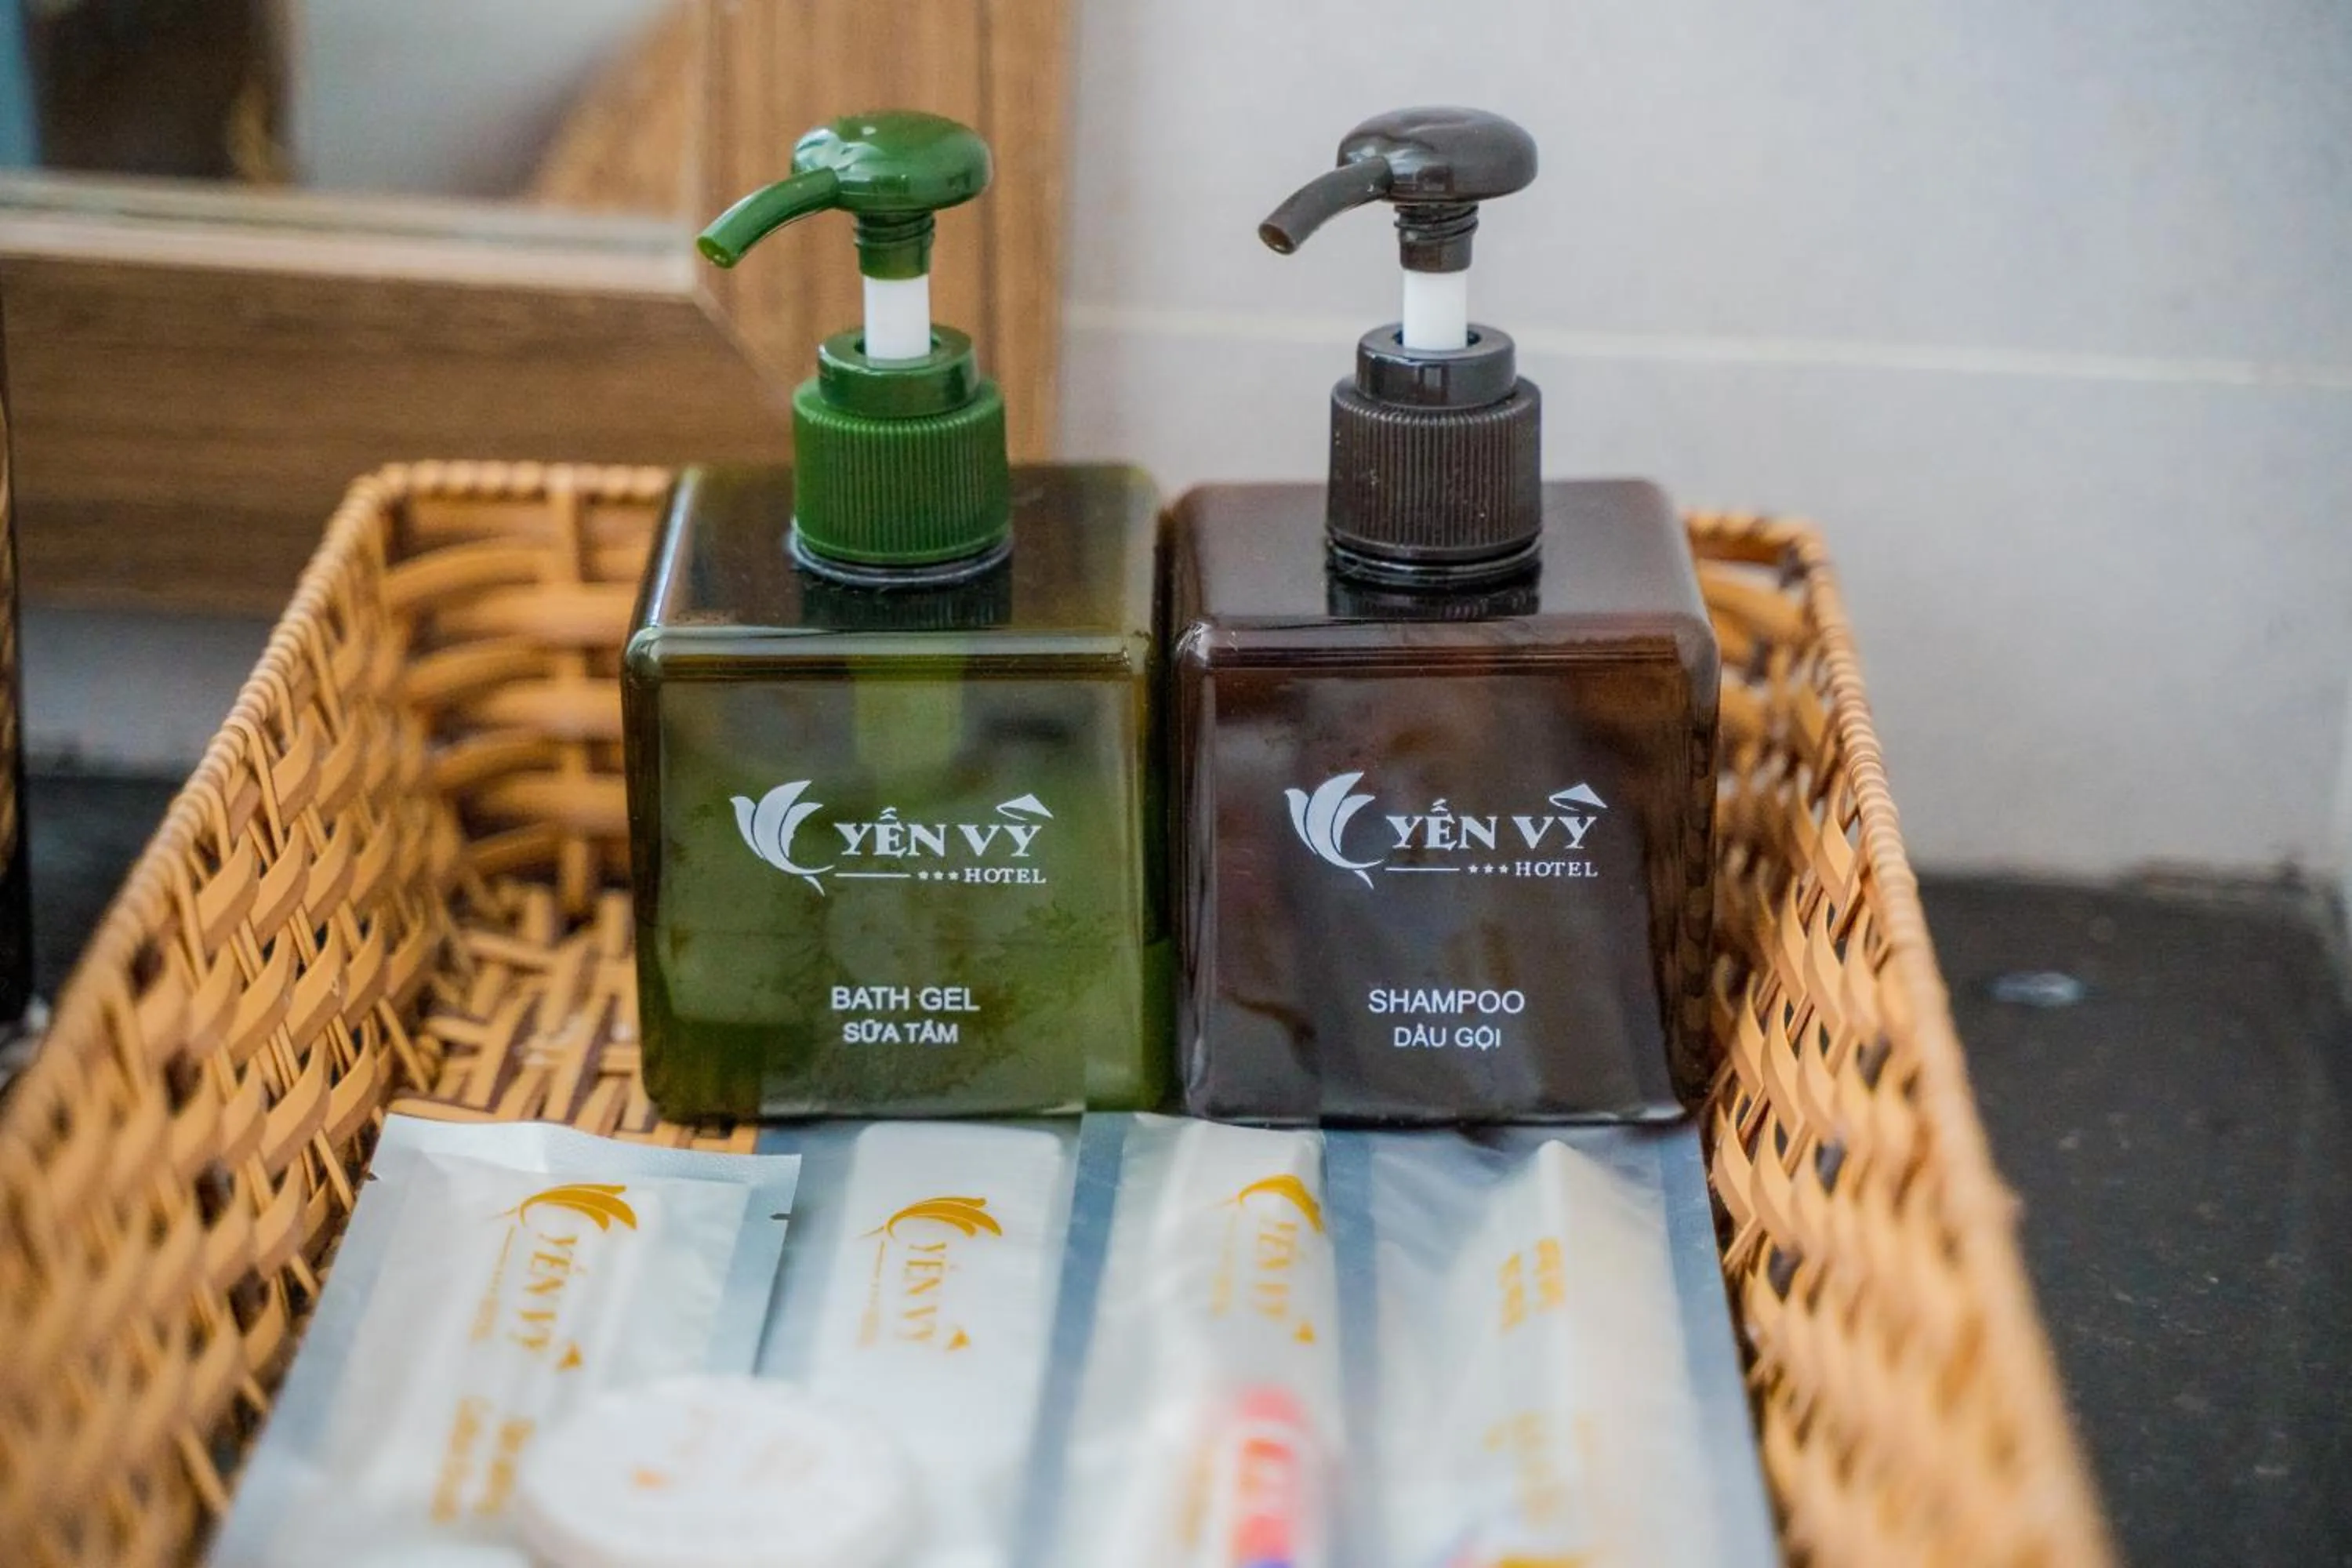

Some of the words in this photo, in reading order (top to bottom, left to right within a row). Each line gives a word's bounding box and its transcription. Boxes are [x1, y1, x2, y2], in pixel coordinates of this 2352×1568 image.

[964, 867, 1047, 884] HOTEL
[1515, 862, 1598, 877] HOTEL
[831, 985, 910, 1011] BATH
[920, 985, 981, 1011] GEL
[1367, 989, 1526, 1014] SHAMPOO
